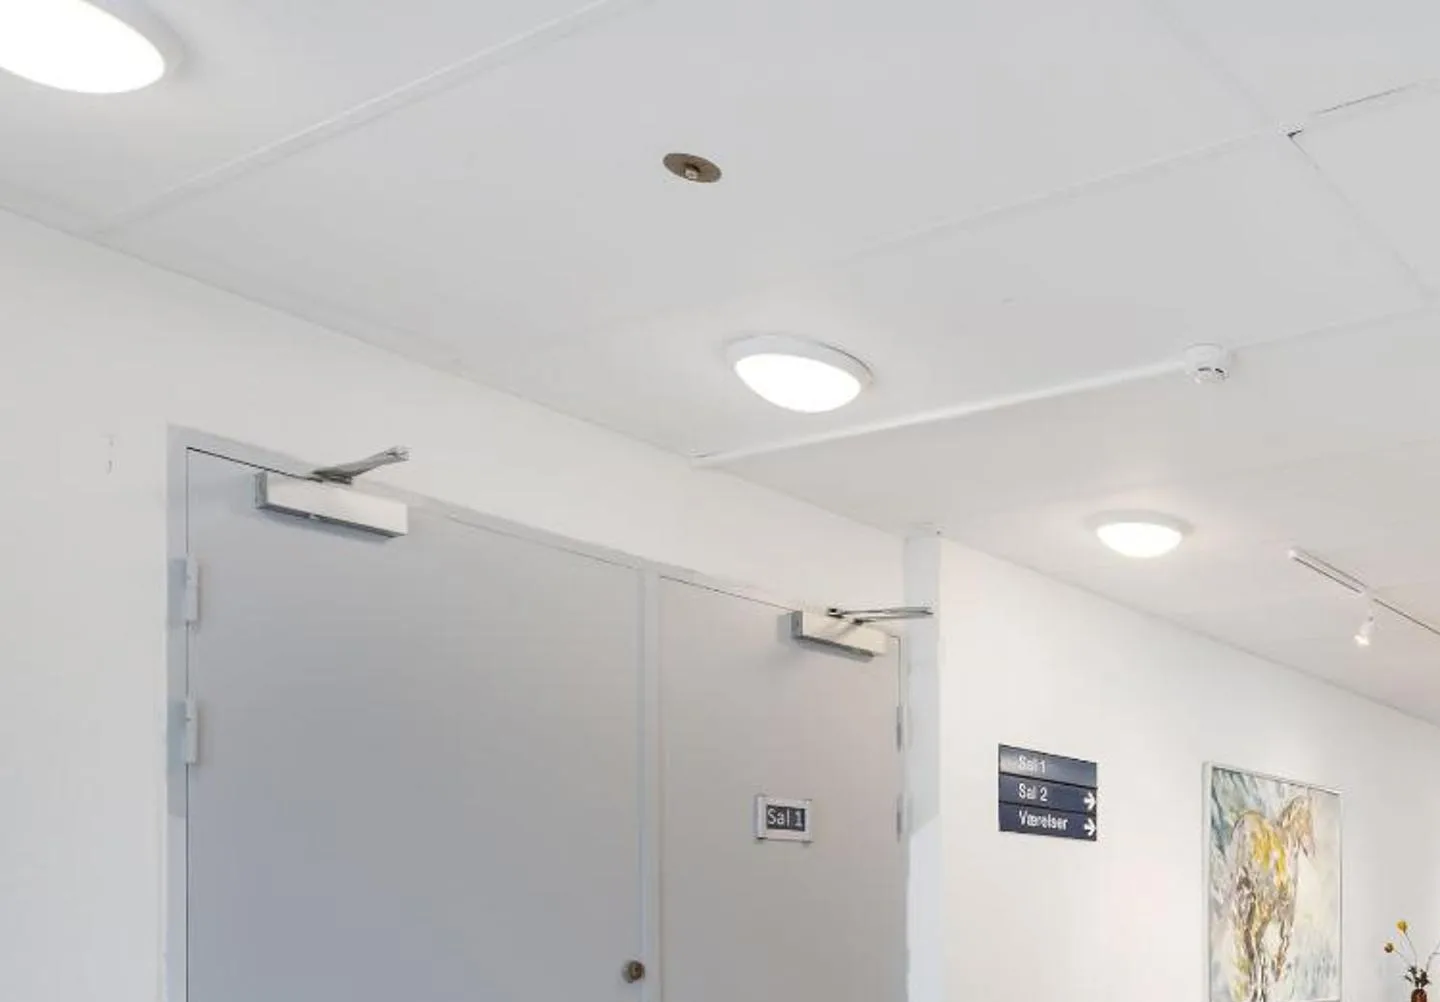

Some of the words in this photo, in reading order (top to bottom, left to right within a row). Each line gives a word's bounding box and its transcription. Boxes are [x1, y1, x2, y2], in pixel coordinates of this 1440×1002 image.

[1039, 759, 1046, 773] 1
[1018, 783, 1037, 800] Sal
[1040, 786, 1048, 802] 2
[767, 808, 790, 827] Sal
[794, 810, 803, 827] 1
[1018, 809, 1069, 831] Værelser
